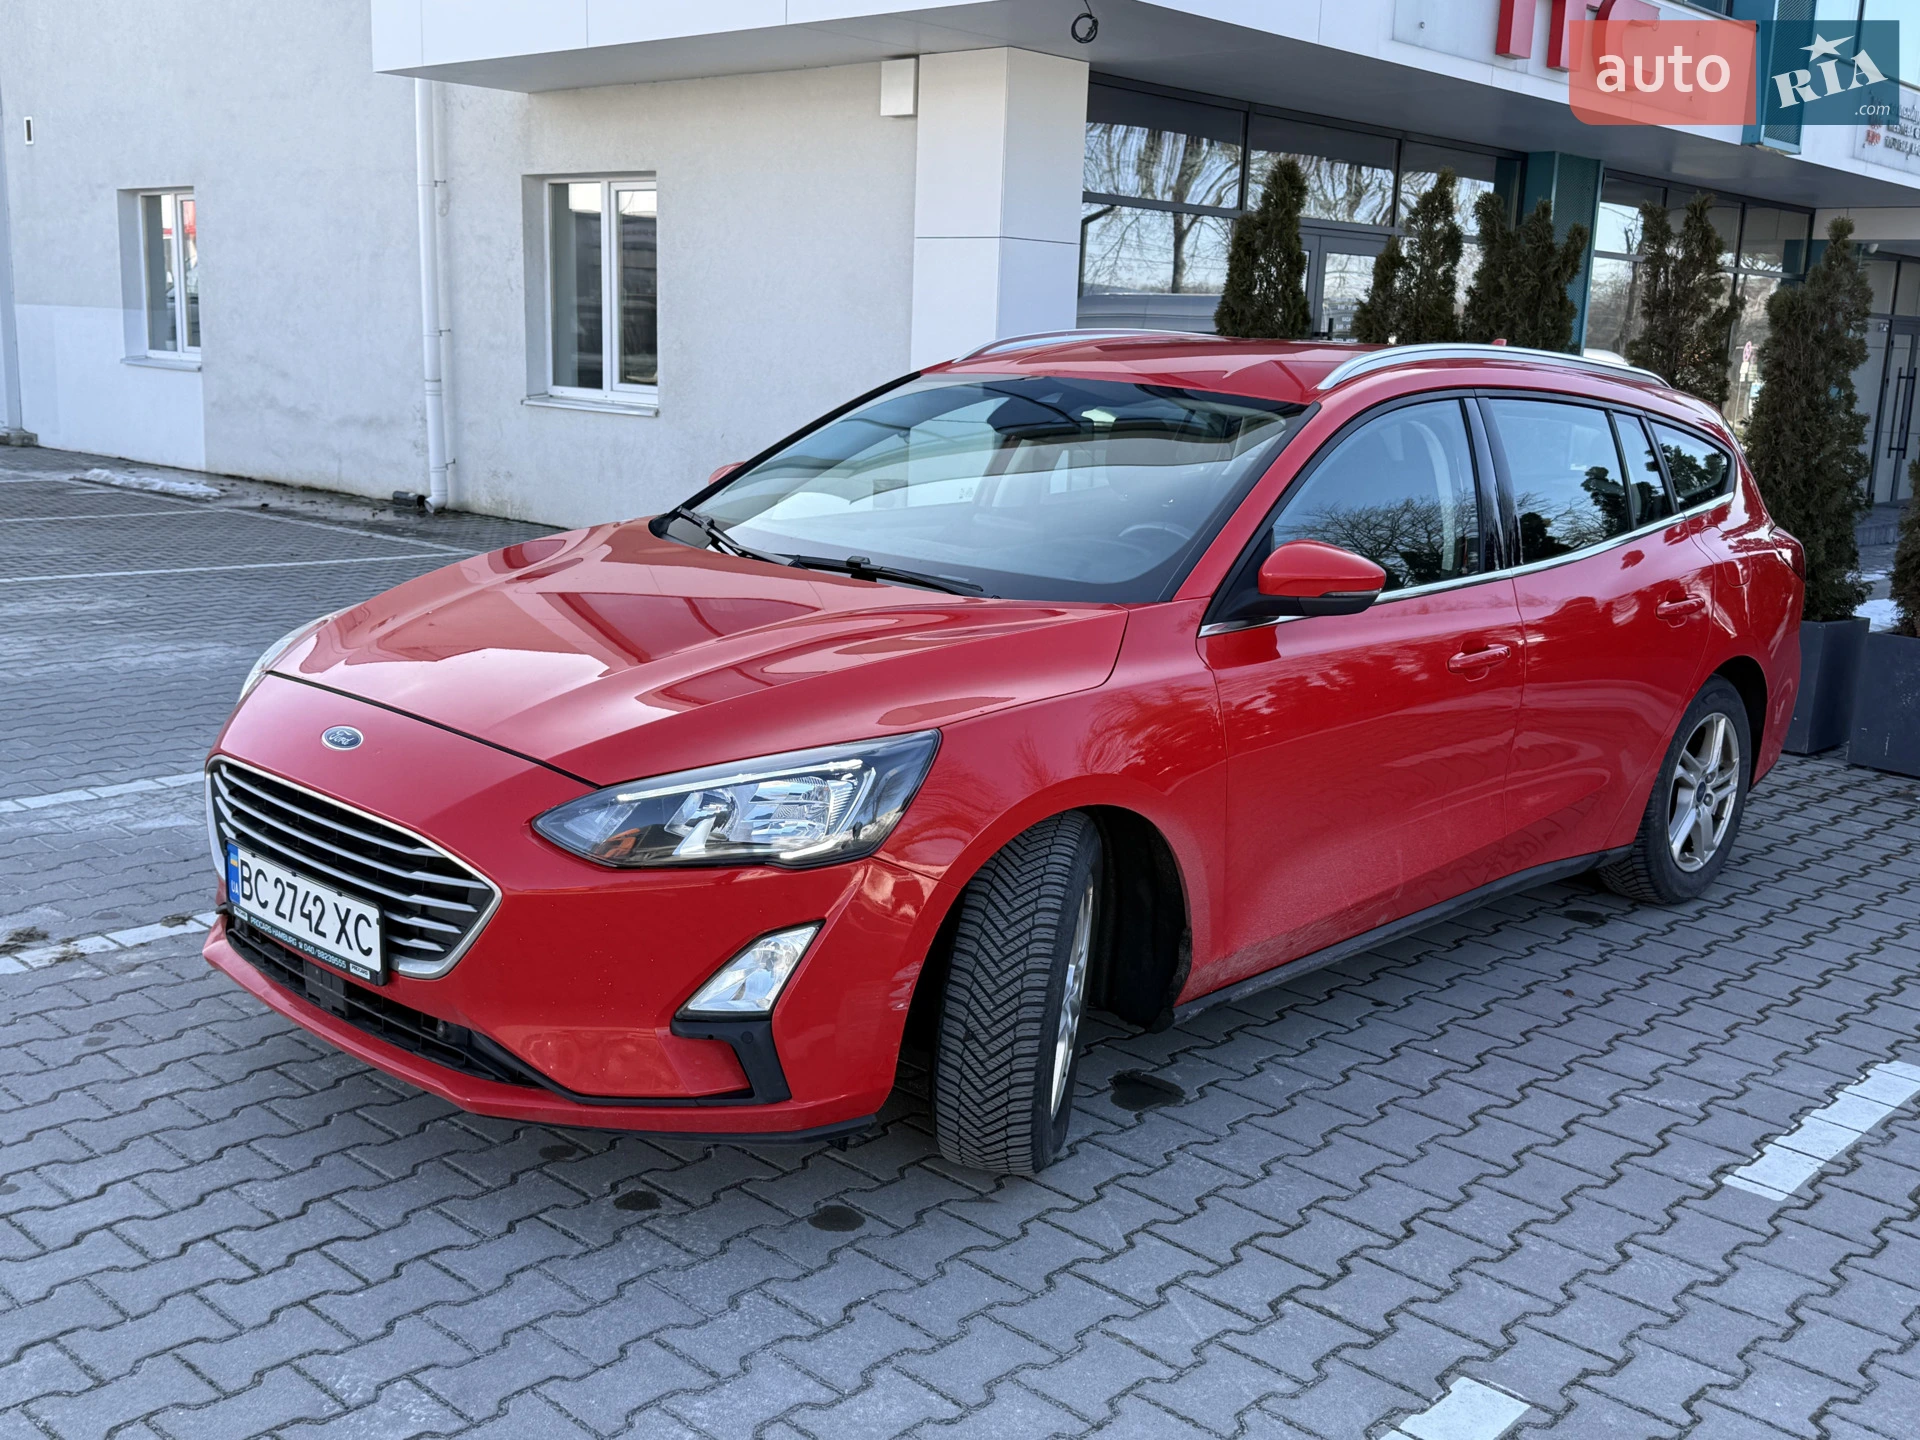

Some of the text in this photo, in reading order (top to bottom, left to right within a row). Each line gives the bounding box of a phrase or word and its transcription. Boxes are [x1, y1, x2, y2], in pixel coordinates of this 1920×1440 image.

[328, 729, 355, 746] Ford
[230, 879, 240, 896] UA
[240, 859, 373, 957] BC 2742 XC
